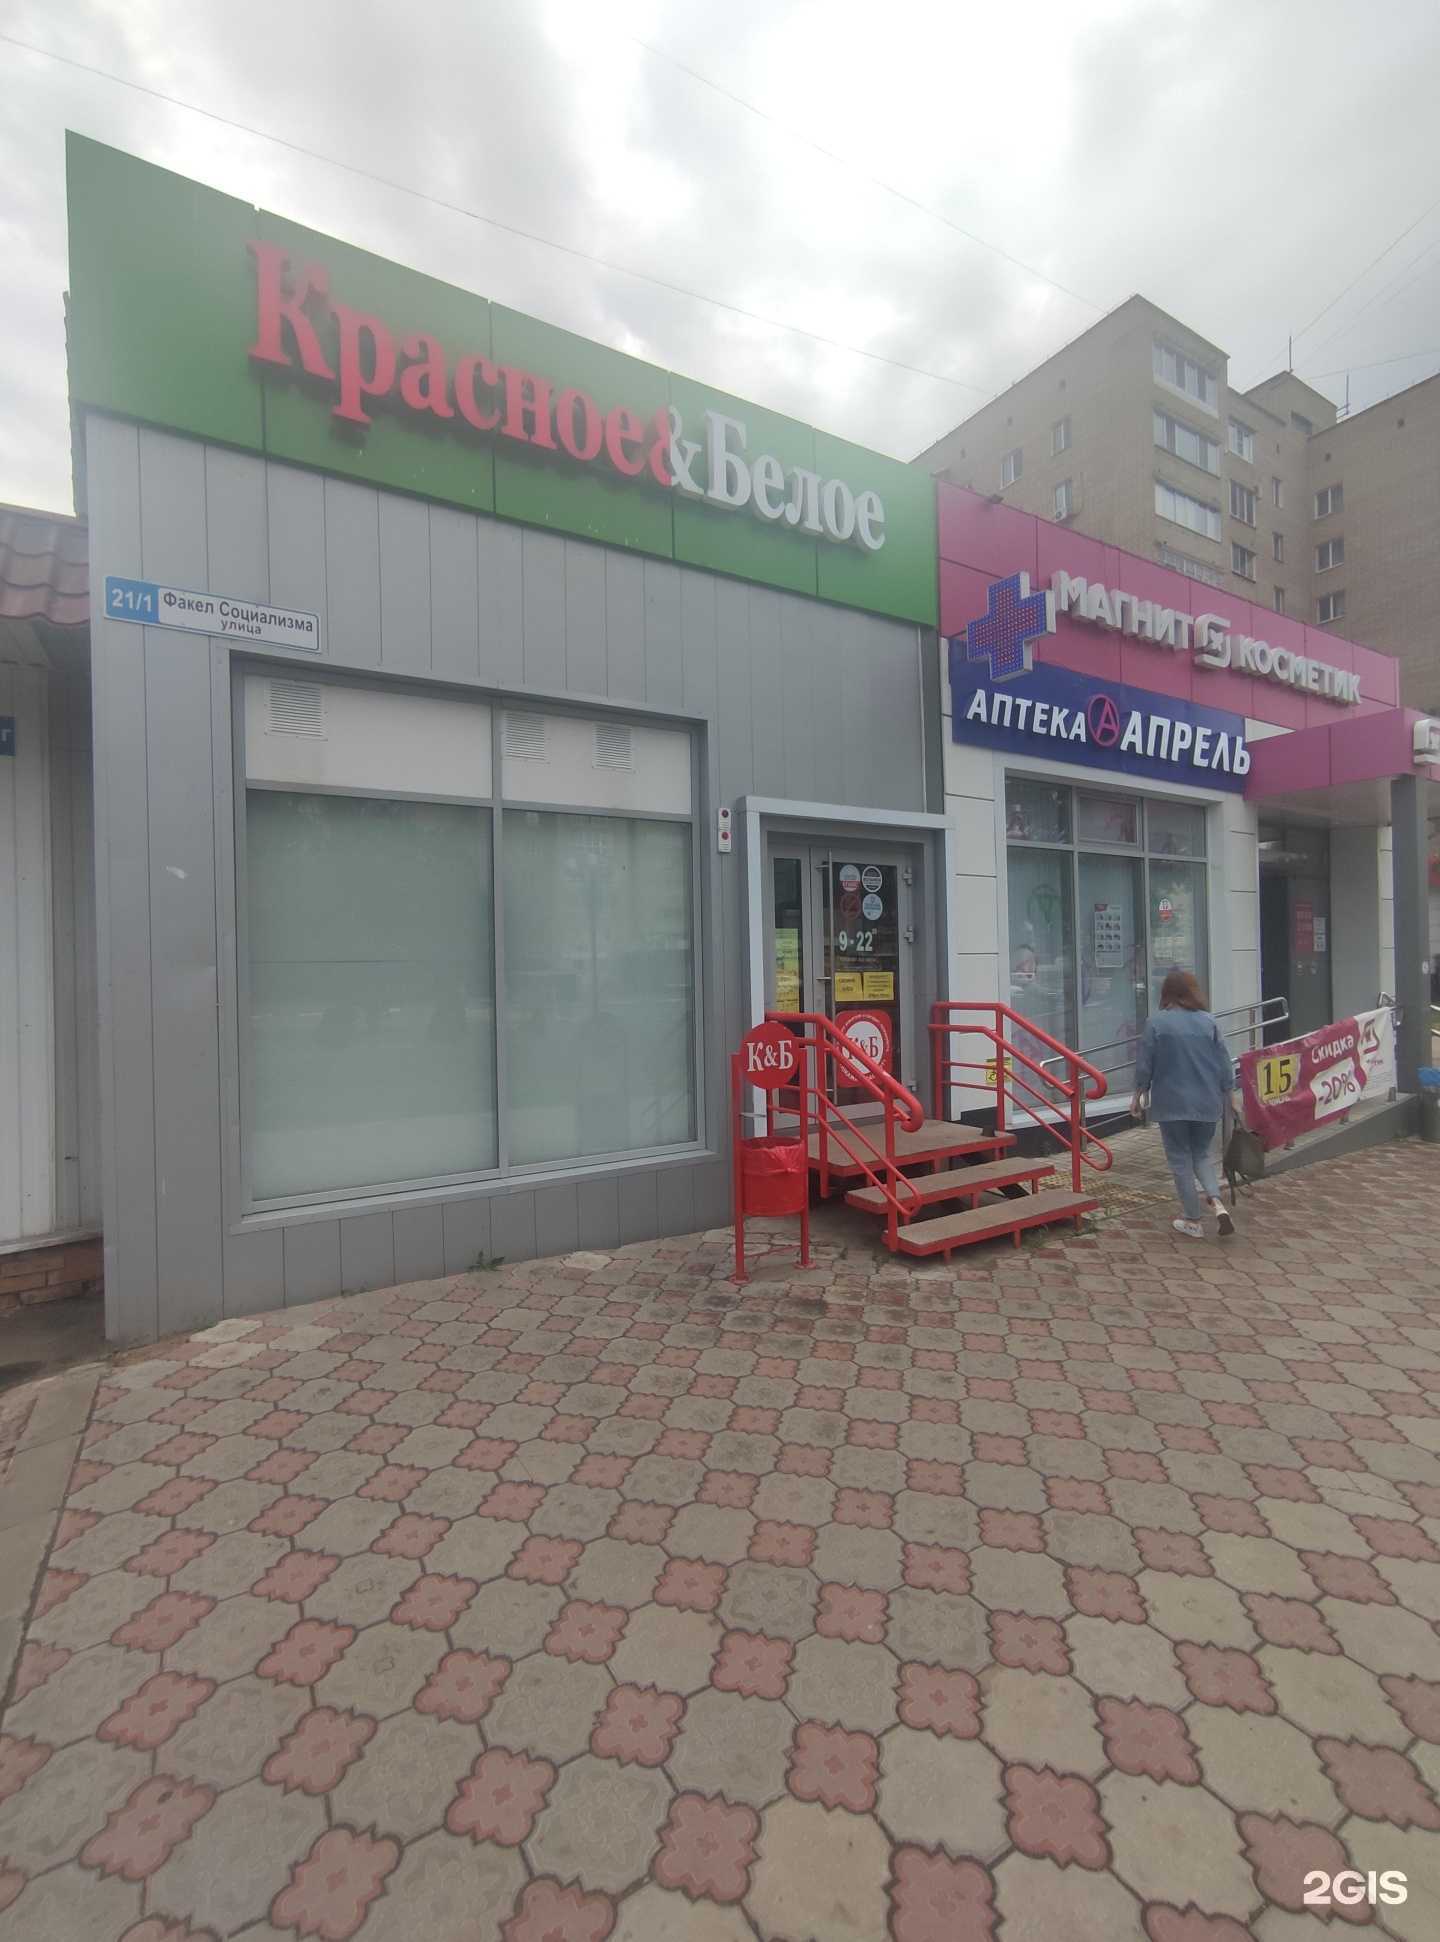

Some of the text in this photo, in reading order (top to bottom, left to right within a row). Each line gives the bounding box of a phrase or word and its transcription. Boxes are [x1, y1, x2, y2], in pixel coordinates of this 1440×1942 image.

[111, 587, 314, 632] 21/1 Факел Социализма
[220, 618, 262, 636] улица
[1052, 570, 1363, 705] МАГНИТ КОСМЕТИК
[966, 688, 1087, 743] АПТЕКА
[1119, 710, 1251, 775] АПРЕЛЬ
[746, 1040, 794, 1072] К&Б
[1263, 1058, 1292, 1096] 15
